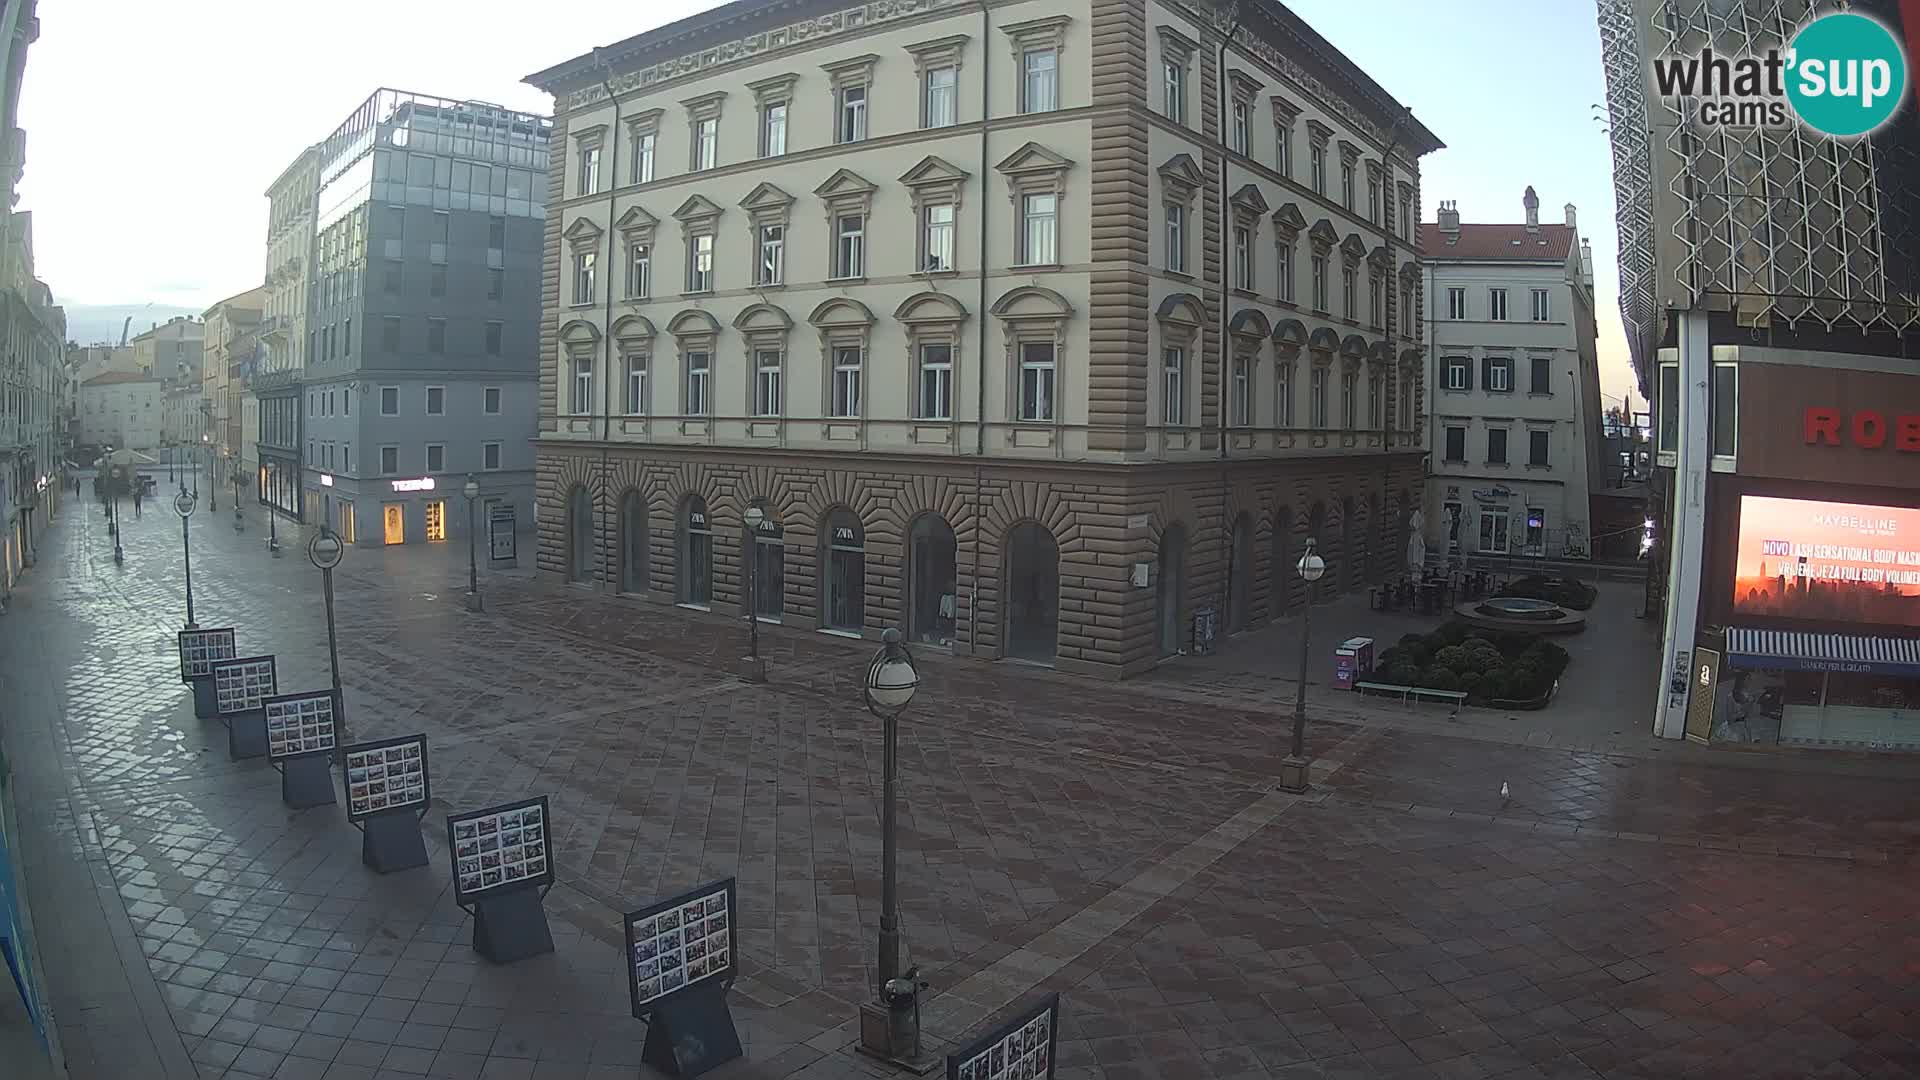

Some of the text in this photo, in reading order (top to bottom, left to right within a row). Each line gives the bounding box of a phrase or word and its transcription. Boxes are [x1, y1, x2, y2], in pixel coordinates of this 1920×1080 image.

[1815, 514, 1896, 530] MAYBELLINE
[1763, 541, 1788, 555] NOVO
[1814, 544, 1873, 562] SENSATIONAL
[1873, 550, 1896, 564] BODY
[1828, 564, 1840, 579] ZA
[1840, 566, 1861, 581] FULL
[1861, 567, 1885, 582] BODY
